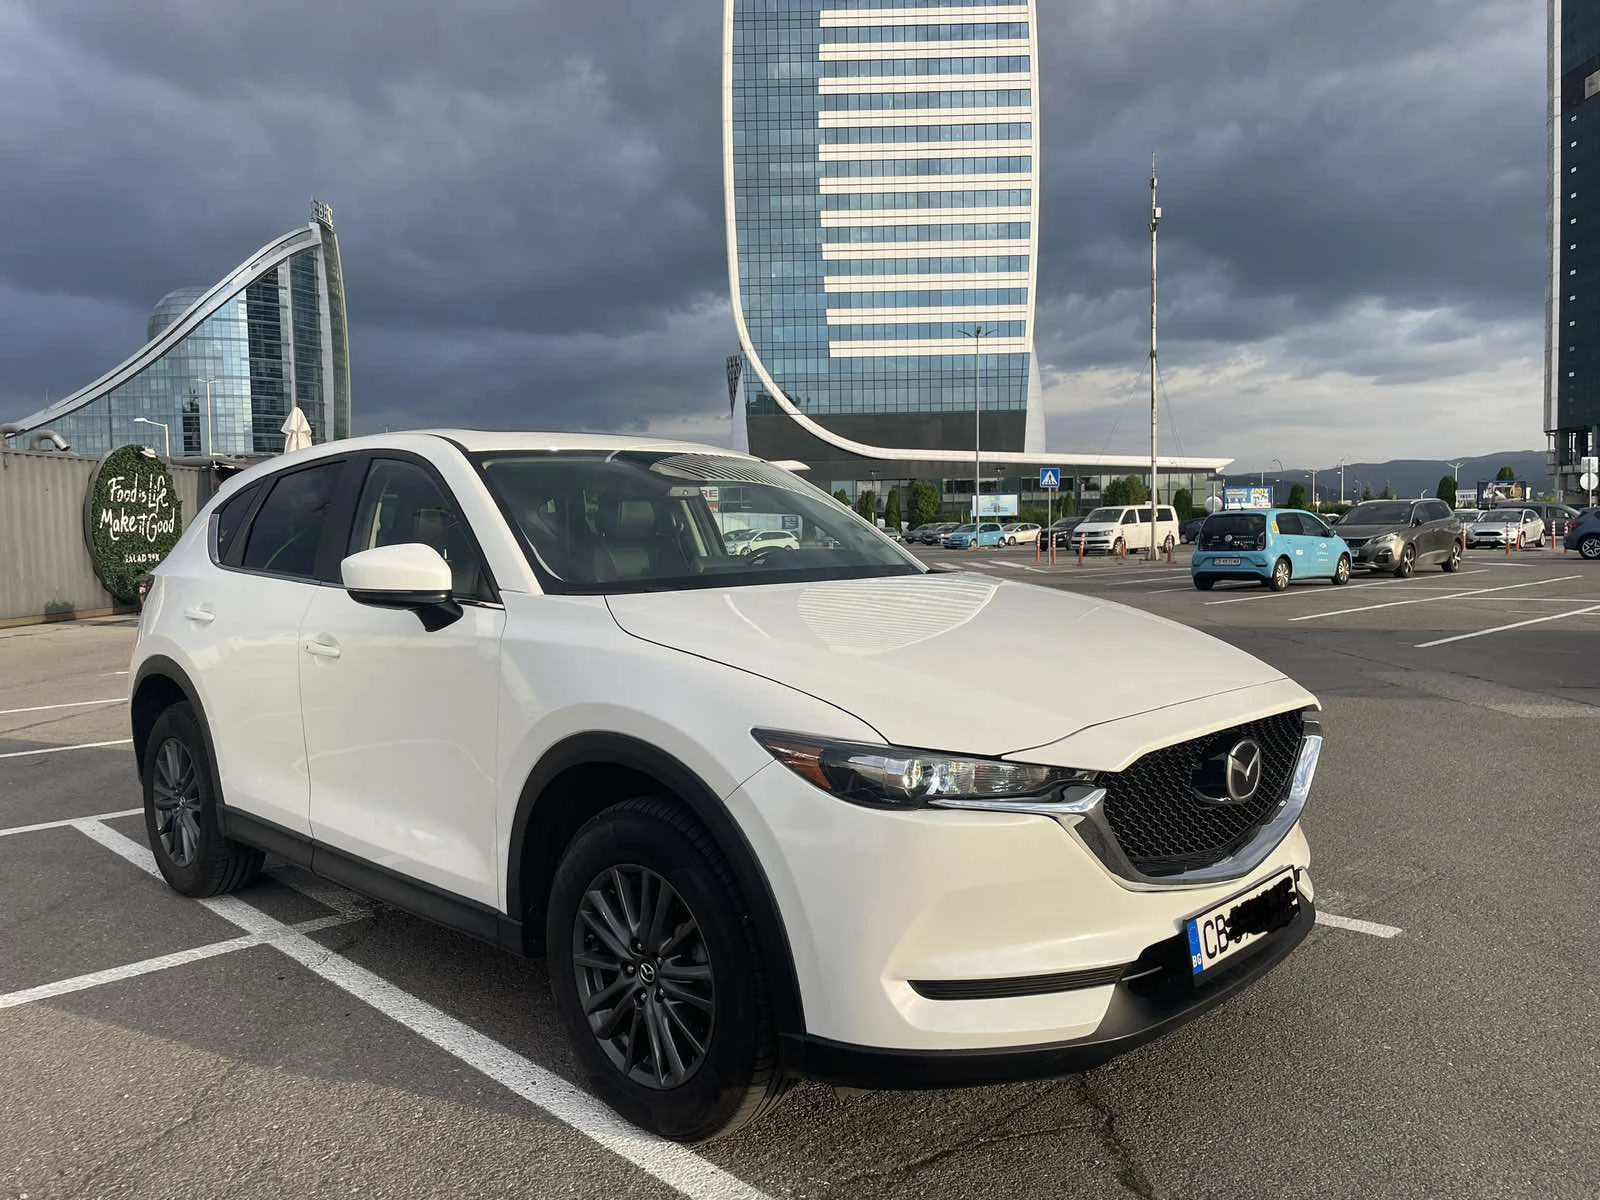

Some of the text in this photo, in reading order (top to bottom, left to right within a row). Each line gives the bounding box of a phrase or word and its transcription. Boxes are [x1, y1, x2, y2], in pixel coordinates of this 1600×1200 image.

[107, 473, 169, 513] Food is Life
[100, 507, 175, 543] Make it Good
